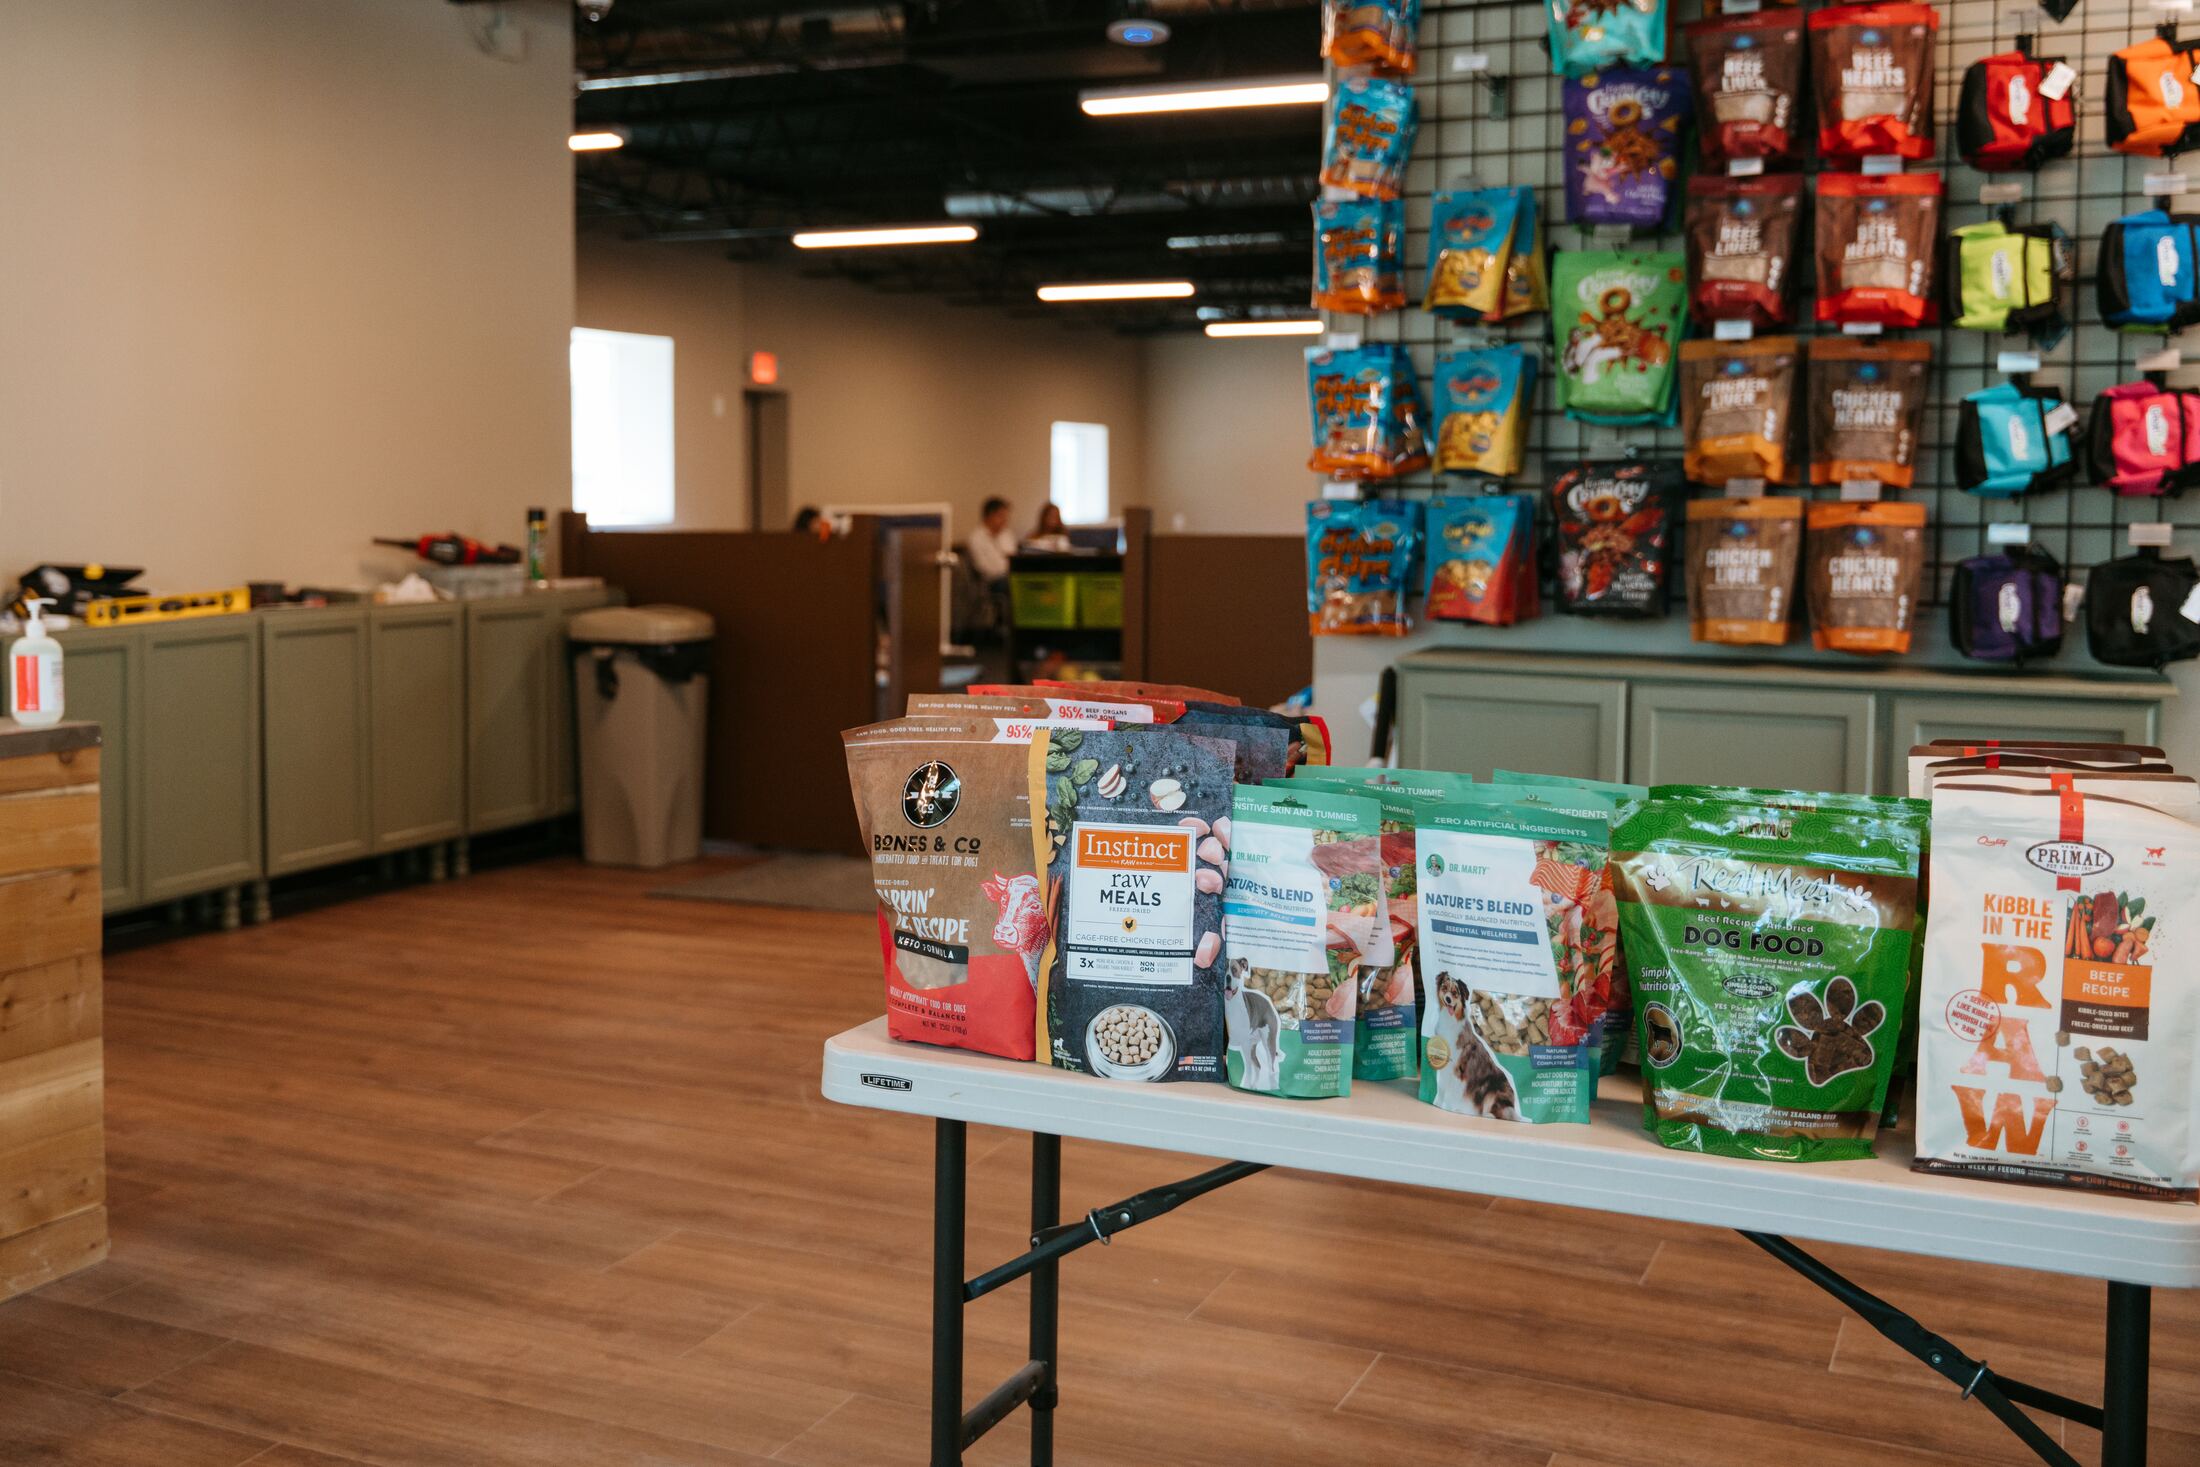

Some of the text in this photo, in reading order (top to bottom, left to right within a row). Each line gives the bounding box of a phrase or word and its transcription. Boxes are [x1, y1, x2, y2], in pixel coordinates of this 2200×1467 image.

[1852, 49, 1894, 69] BEEF
[1841, 67, 1905, 87] HEARTS
[1058, 706, 1084, 720] 95%
[1006, 724, 1032, 739] 95%
[1232, 802, 1358, 822] ENSITIVE SKIN AND TUMMIES
[1434, 816, 1588, 838] ZERO ARTIFICIAL INGREDIENTS
[874, 834, 927, 852] BONES
[934, 836, 946, 852] &
[1085, 834, 1178, 860] Instinct
[1246, 852, 1269, 863] MARTY
[2038, 848, 2104, 867] PRIMAL
[1461, 864, 1487, 876] MARTY
[1111, 873, 1152, 888] raw
[1678, 856, 1835, 903] Real Meat
[1226, 878, 1314, 902] ATURE'S BLEND
[1100, 890, 1162, 906] MEALS
[1426, 892, 1534, 916] NATURE'S BLEND
[1984, 894, 2053, 919] KIBBLE
[1465, 915, 1498, 924] BALANCED
[1500, 918, 1536, 928] NUTRITION
[1697, 914, 1720, 924] Beef
[912, 916, 970, 943] RECIPE
[1446, 925, 1518, 940] ESSENTIAL WELLNESS
[1982, 915, 2052, 940] IN THE
[898, 936, 954, 959] KETO FORMULA
[1076, 934, 1184, 946] CAGE-FREE CHICKEN RECIPE
[1684, 926, 1824, 958] DOG FOOD
[1080, 958, 1094, 968] 3x
[1752, 956, 1777, 964] Zealand
[1778, 958, 1792, 966] Beef
[2090, 970, 2125, 983] BEEF
[2082, 982, 2130, 998] RECIPE
[1957, 1001, 1971, 1012] LIKE
[1970, 996, 1990, 1008] SERVE
[928, 1010, 966, 1022] BALANCED
[1952, 1010, 1979, 1026] NOURISH
[2078, 1008, 2112, 1017] KIBBLE-SIZED
[2071, 1020, 2108, 1030] FREEZE-DRIED
[867, 1076, 906, 1089] LIFETIME
[1772, 1110, 1788, 1118] NEW
[1790, 1112, 1821, 1120] ZEALAND
[1998, 1166, 2026, 1174] FEEDING
